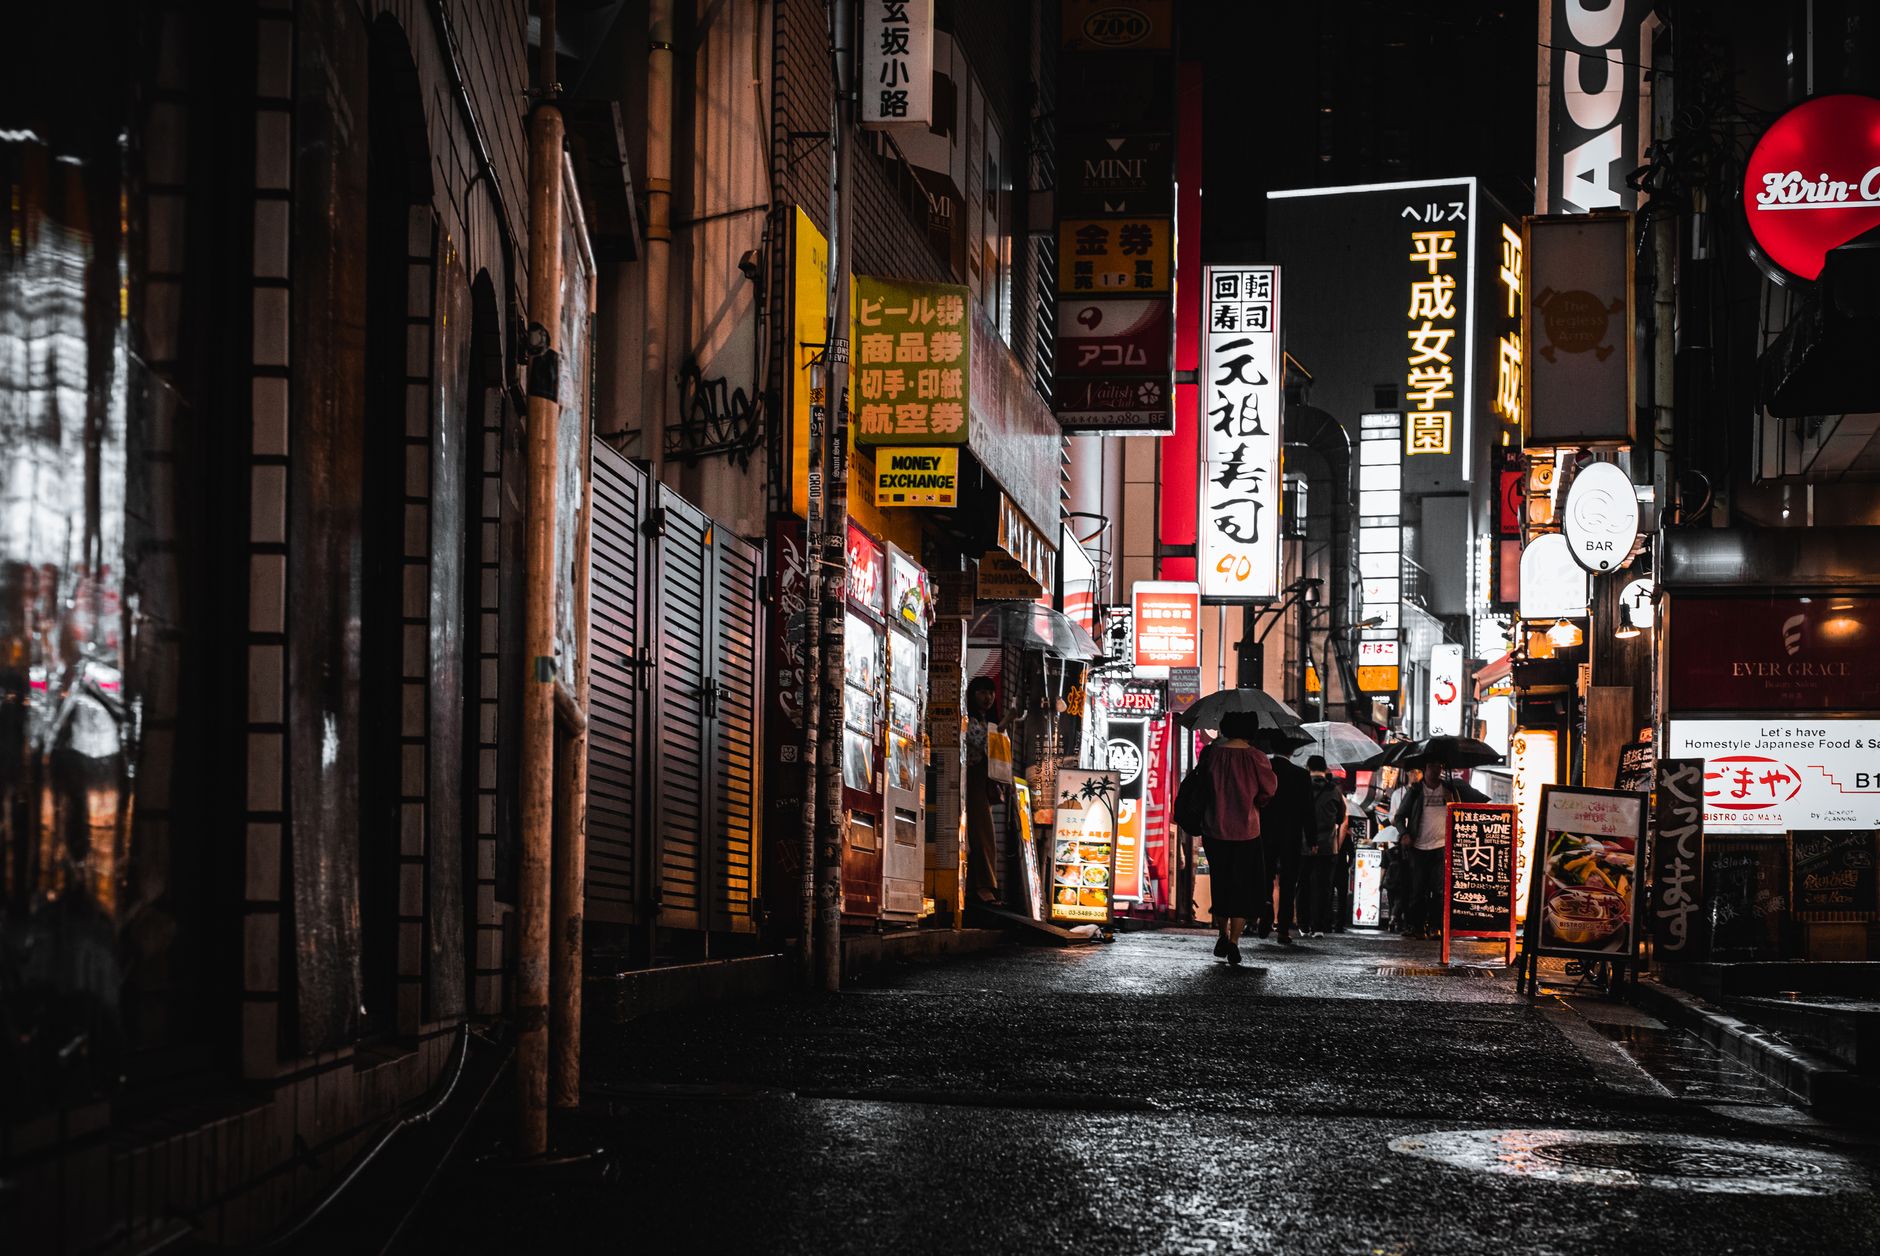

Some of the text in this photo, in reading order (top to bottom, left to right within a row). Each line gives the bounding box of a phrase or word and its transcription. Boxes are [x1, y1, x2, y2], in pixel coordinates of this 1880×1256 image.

[1083, 158, 1148, 179] MINT
[1401, 202, 1467, 223] ヘルス
[1075, 224, 1153, 256] 金券
[861, 332, 963, 364] 商品券
[1407, 230, 1457, 455] 平成女学園
[1078, 344, 1147, 368] アコム
[861, 368, 963, 400] 切手・印紙
[860, 403, 964, 434] 航空券
[1208, 338, 1270, 544] 元祖寿司
[891, 456, 942, 470] MONEY
[879, 474, 955, 489] EXCHANGE
[1586, 541, 1613, 551] BAR
[1732, 662, 1850, 676] EVER GRACE
[1113, 693, 1156, 709] OPEN
[1795, 727, 1826, 738] have
[1685, 739, 1751, 750] Homestyle
[1754, 739, 1815, 750] Japanese
[1818, 739, 1851, 749] Food
[1855, 739, 1864, 749] &
[1703, 766, 1792, 799] ごまや
[1703, 813, 1737, 821] BISTRO
[1742, 813, 1755, 821] GO
[1757, 813, 1770, 821] MA
[1811, 812, 1821, 820] by
[1482, 823, 1511, 834] WINE
[1462, 837, 1495, 873] 肉
[1657, 762, 1701, 951] やってます
[1559, 892, 1621, 918] ごまや
